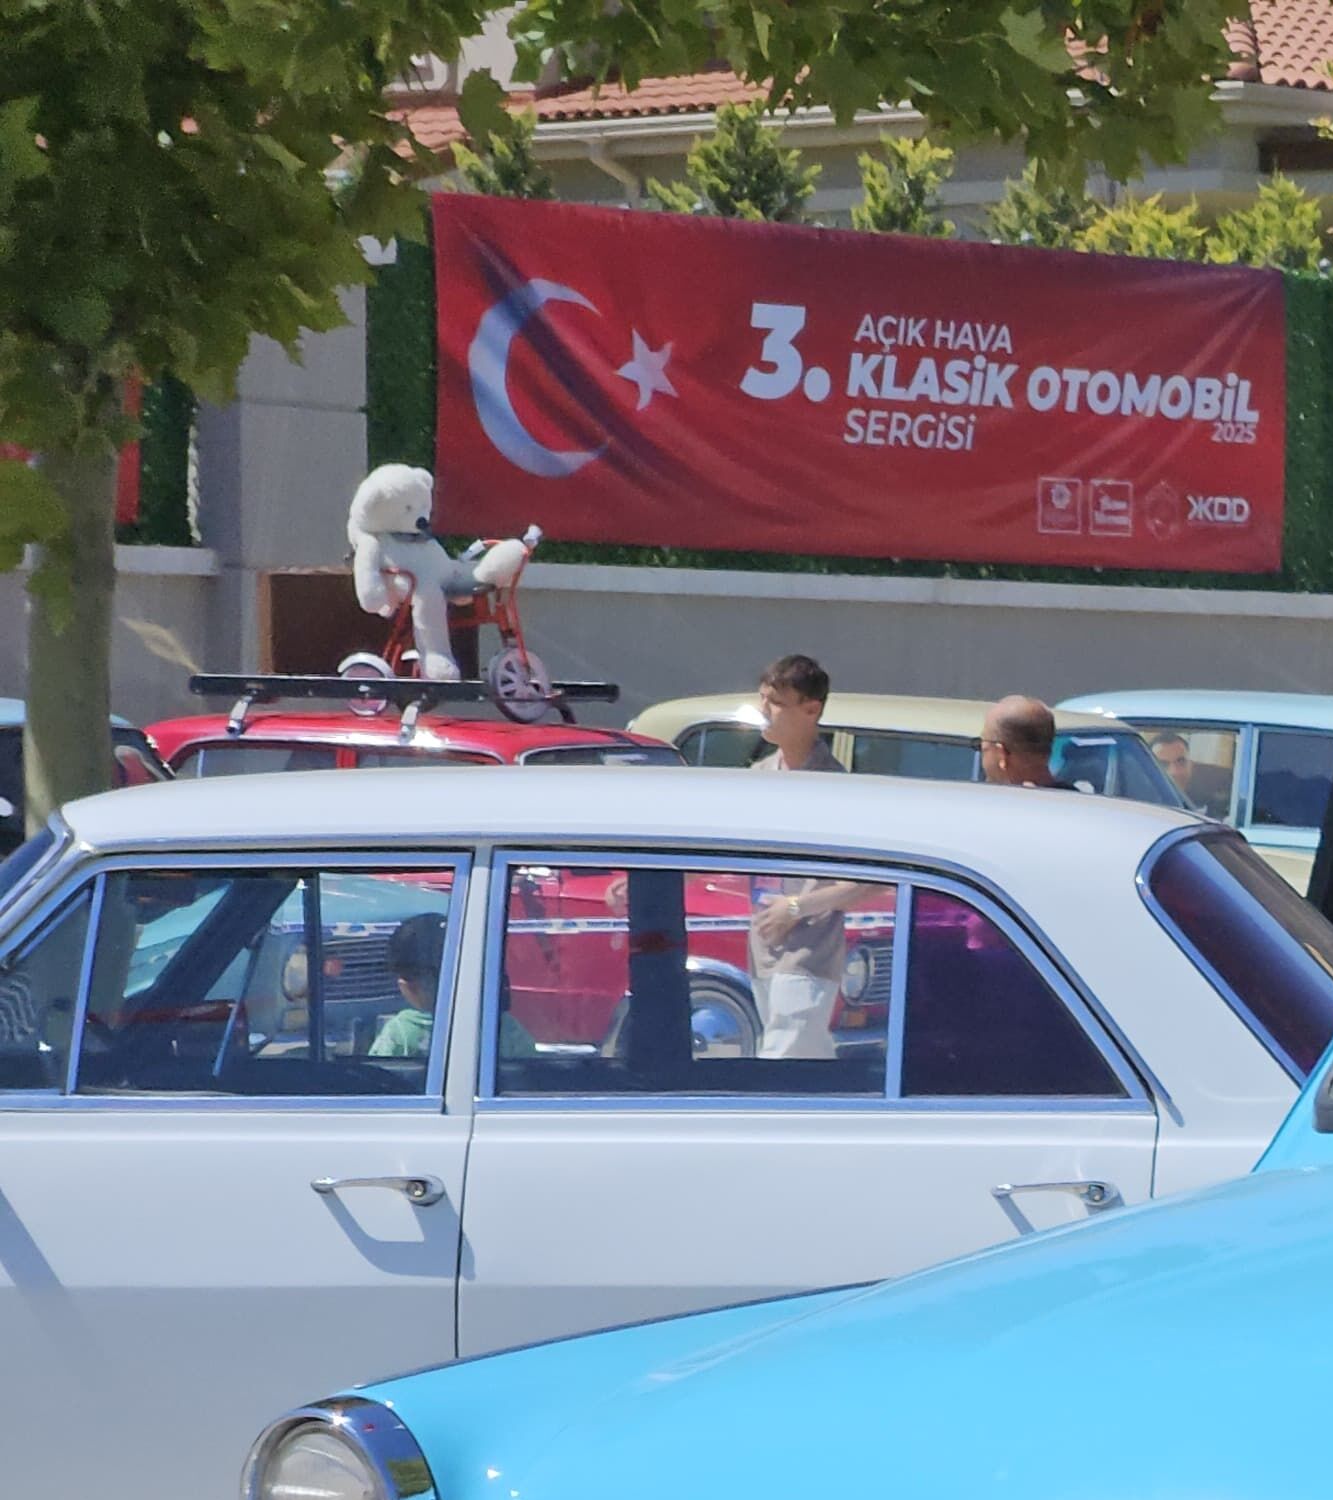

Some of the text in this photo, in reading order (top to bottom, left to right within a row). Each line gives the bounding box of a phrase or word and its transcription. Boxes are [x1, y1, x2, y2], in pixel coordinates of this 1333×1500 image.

[740, 302, 831, 402] 3.
[854, 313, 1012, 354] AÇIK HAVA
[1211, 421, 1257, 445] 2025
